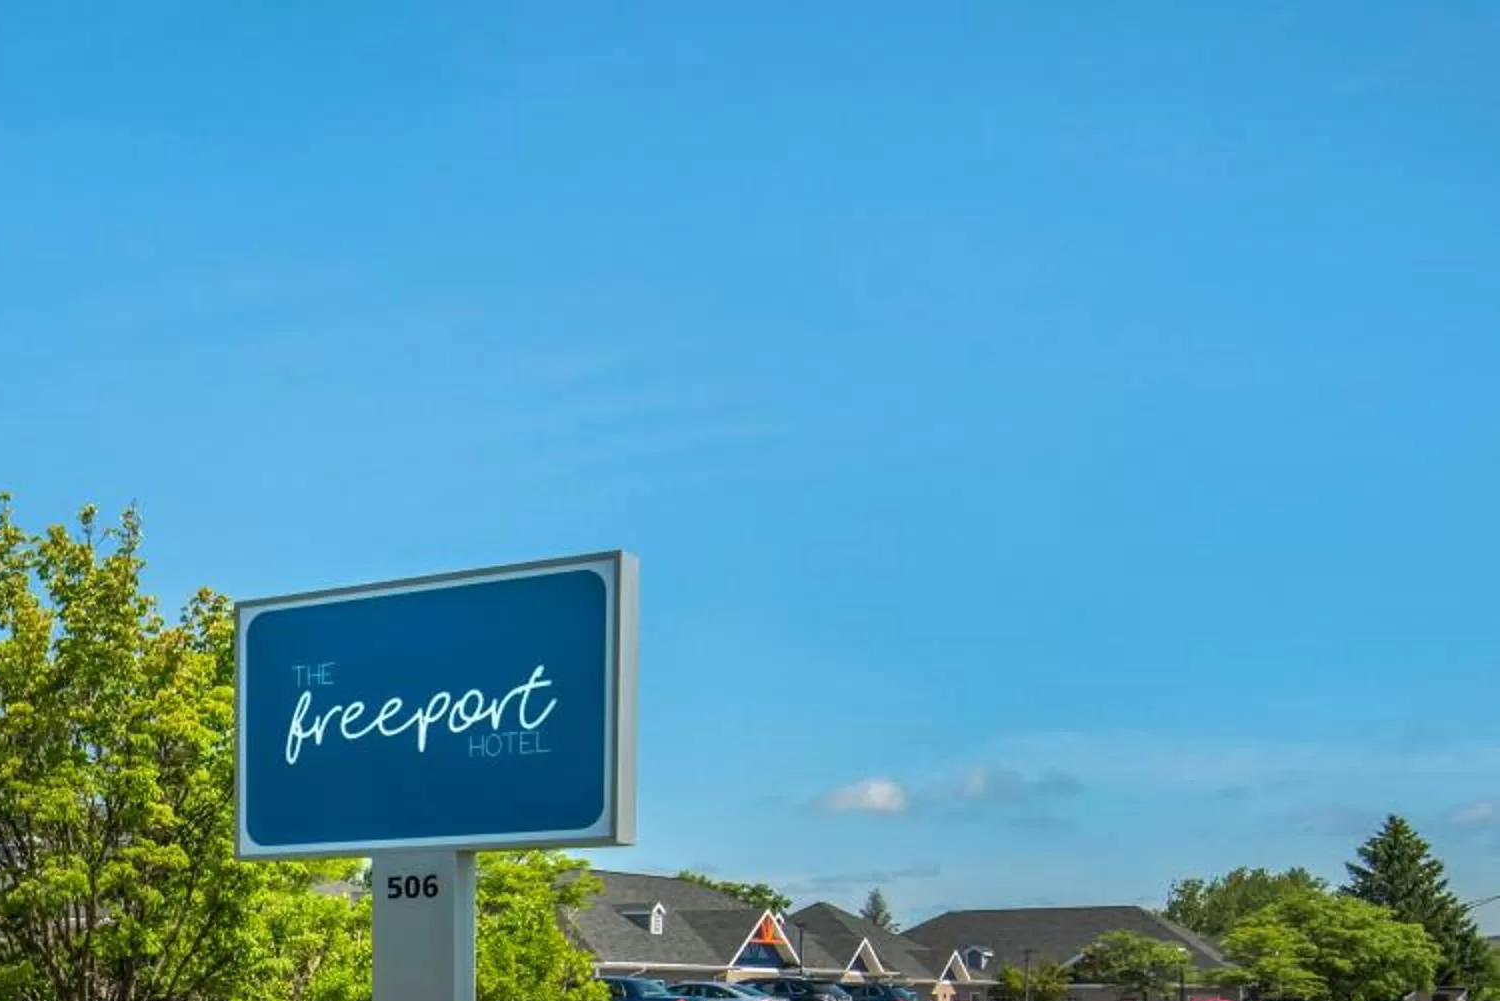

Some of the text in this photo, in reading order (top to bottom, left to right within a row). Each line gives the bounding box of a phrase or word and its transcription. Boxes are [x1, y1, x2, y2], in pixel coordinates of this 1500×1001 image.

[292, 661, 337, 688] THE
[285, 664, 558, 765] freeport
[468, 731, 552, 758] HOTEL
[387, 873, 440, 900] 506
